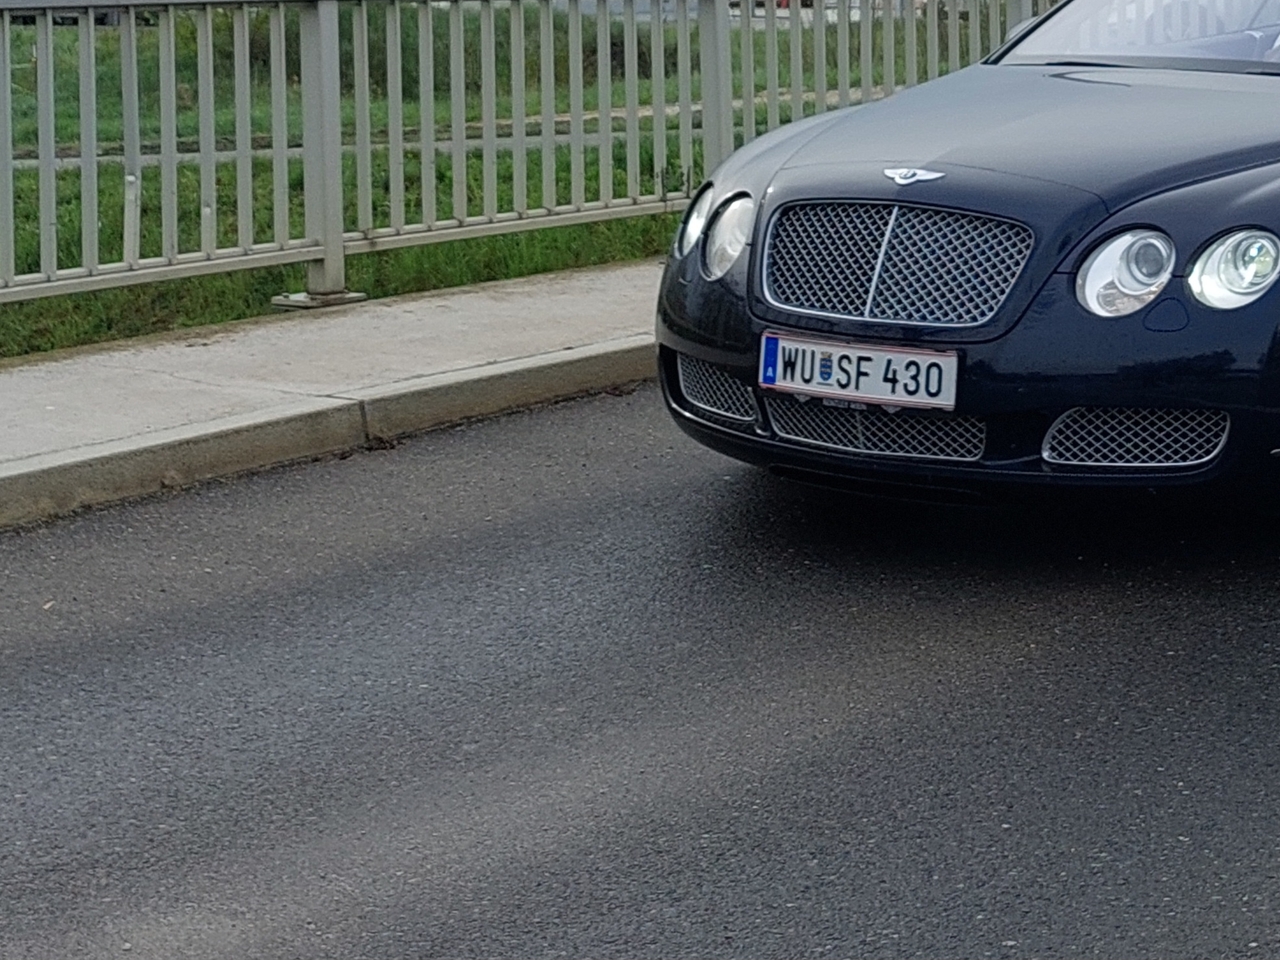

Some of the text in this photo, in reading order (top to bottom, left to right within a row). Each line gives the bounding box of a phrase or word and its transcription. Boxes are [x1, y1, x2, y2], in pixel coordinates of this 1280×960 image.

[781, 345, 944, 398] WU SF 430
